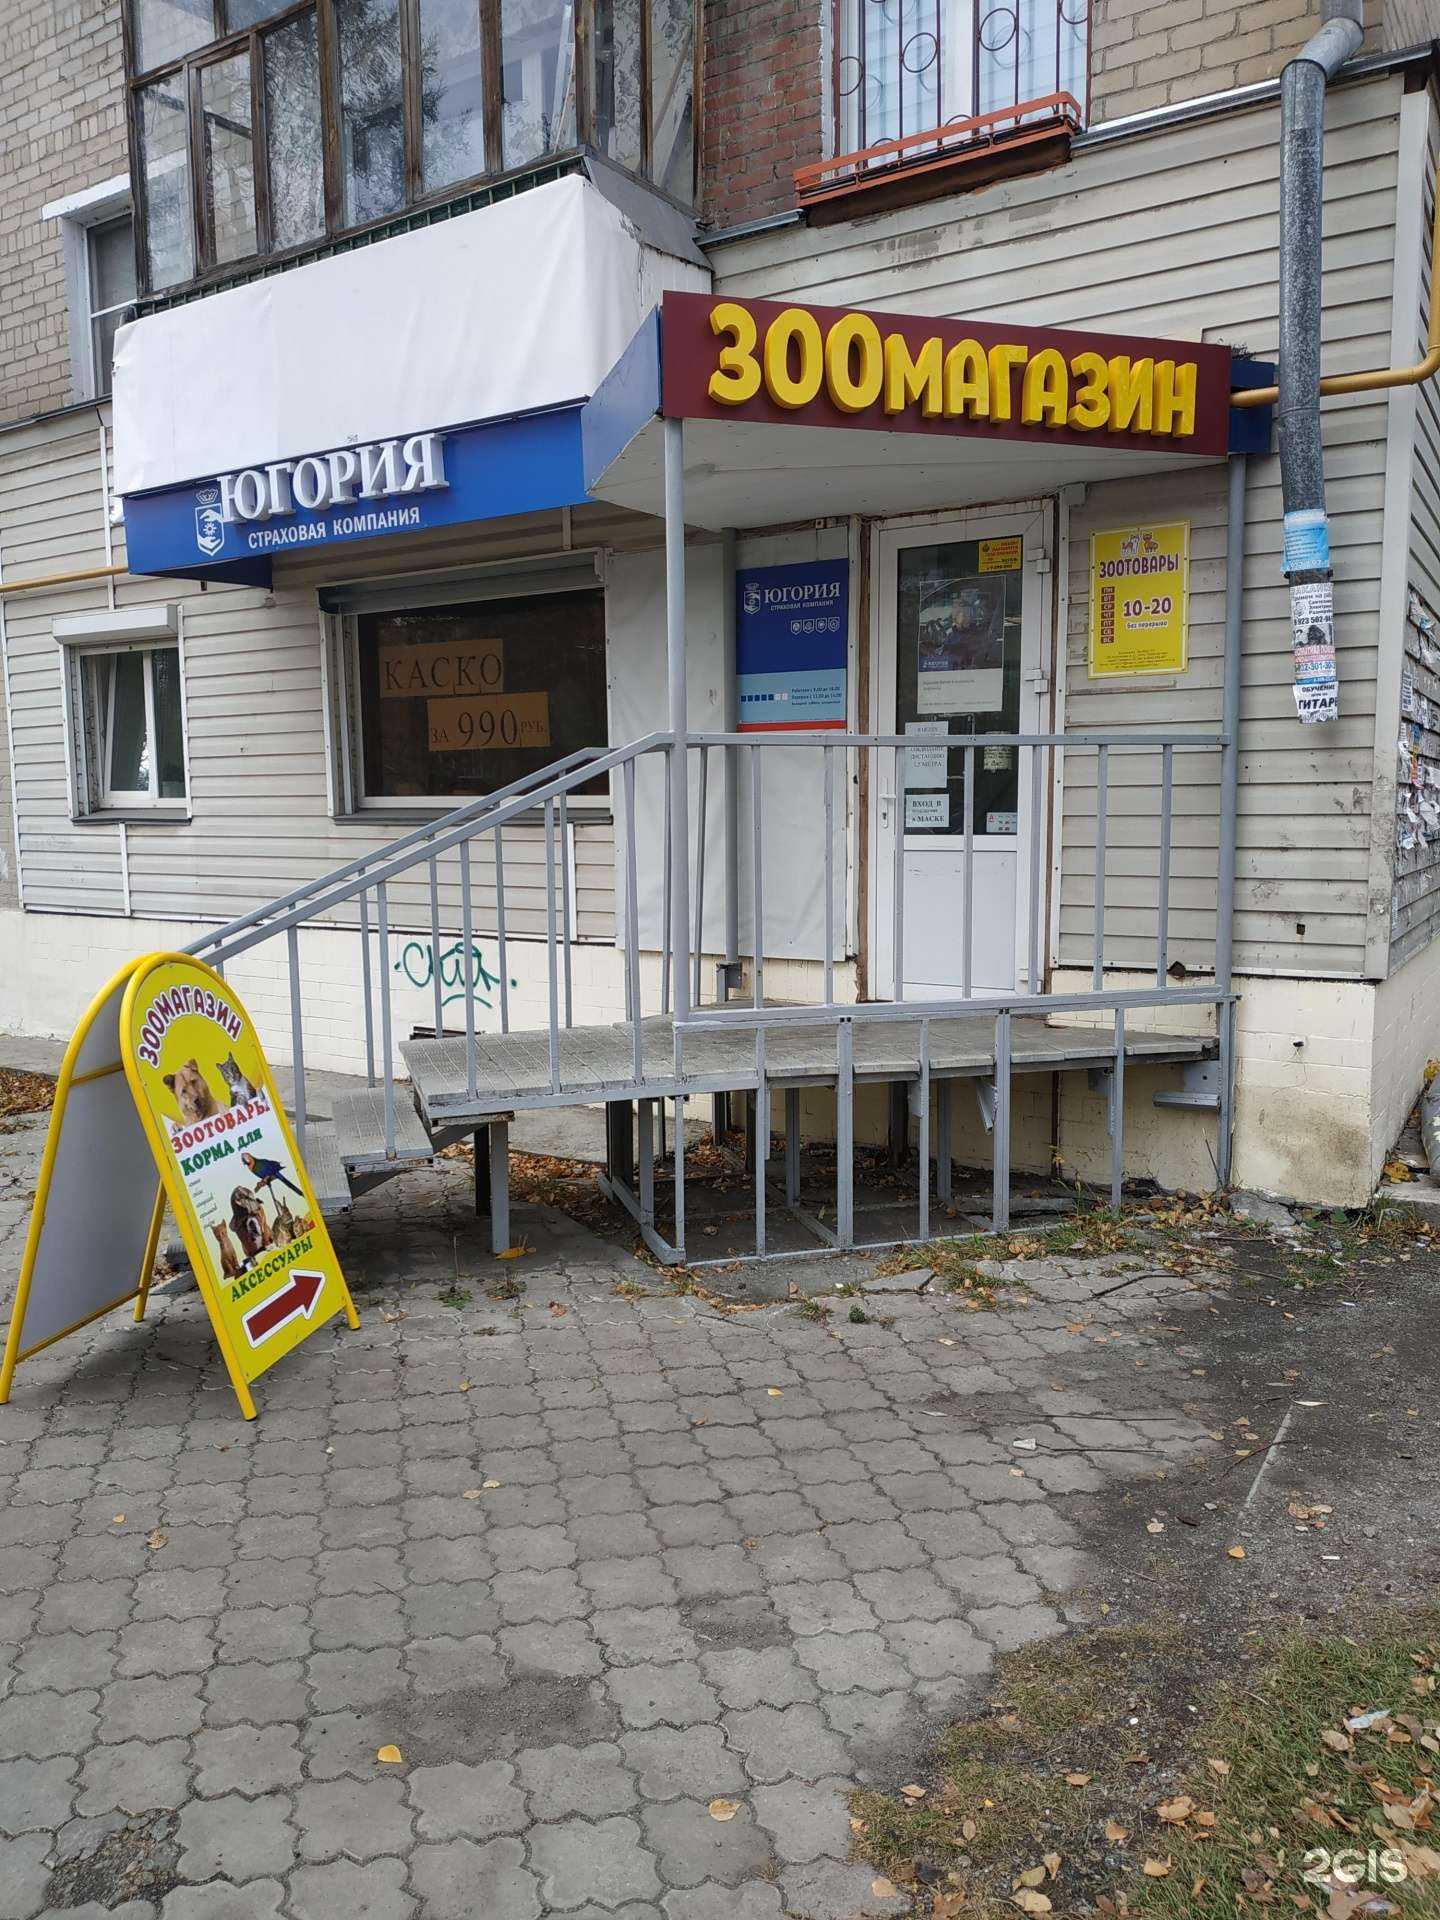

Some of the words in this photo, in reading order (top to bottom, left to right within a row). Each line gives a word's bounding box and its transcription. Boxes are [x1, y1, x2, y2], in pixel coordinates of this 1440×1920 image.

[709, 303, 1197, 438] ЗООМАГАЗИН
[217, 433, 449, 523] ЮГОРИЯ
[248, 521, 326, 549] СТРАХОВАЯ
[333, 507, 420, 536] КОМПАНИЯ
[1099, 553, 1179, 579] ЗООТОВАРЫ
[764, 582, 840, 604] ЮГОРИЯ
[1123, 597, 1172, 617] 10-20
[384, 653, 501, 690] КАСКО
[430, 727, 449, 744] ЗА
[458, 708, 518, 747] 990
[912, 800, 934, 808] ВХОД
[917, 815, 945, 823] МАСКЕ
[138, 985, 242, 1067] ЗООМАГАЗИН
[180, 1139, 235, 1176] КОРМА
[231, 1236, 313, 1302] АКСЕССУАРЫ
